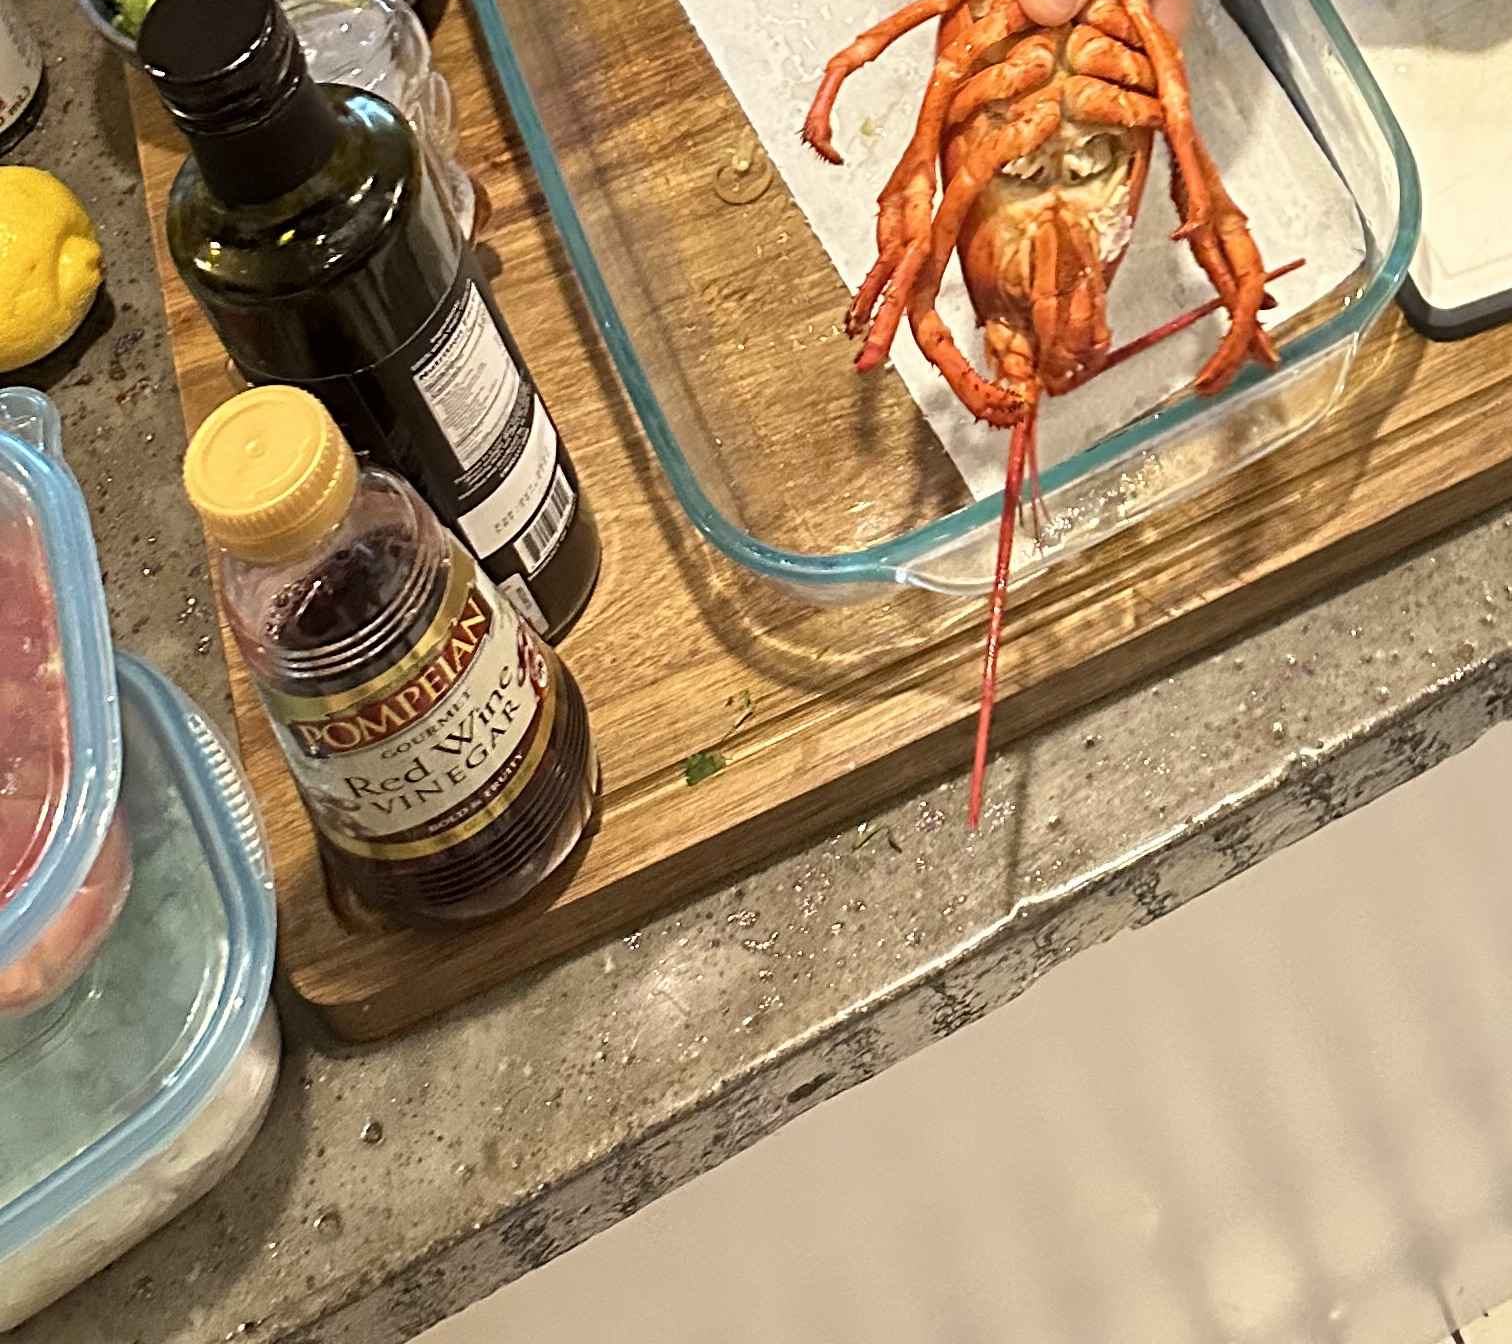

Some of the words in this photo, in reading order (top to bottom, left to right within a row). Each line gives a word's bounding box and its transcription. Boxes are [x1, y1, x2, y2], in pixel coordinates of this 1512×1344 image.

[296, 598, 486, 754] POMPEIAN
[344, 757, 434, 799] Red
[431, 665, 513, 755] Wine
[381, 688, 472, 759] GOURMET
[371, 699, 521, 815] VINEGAR
